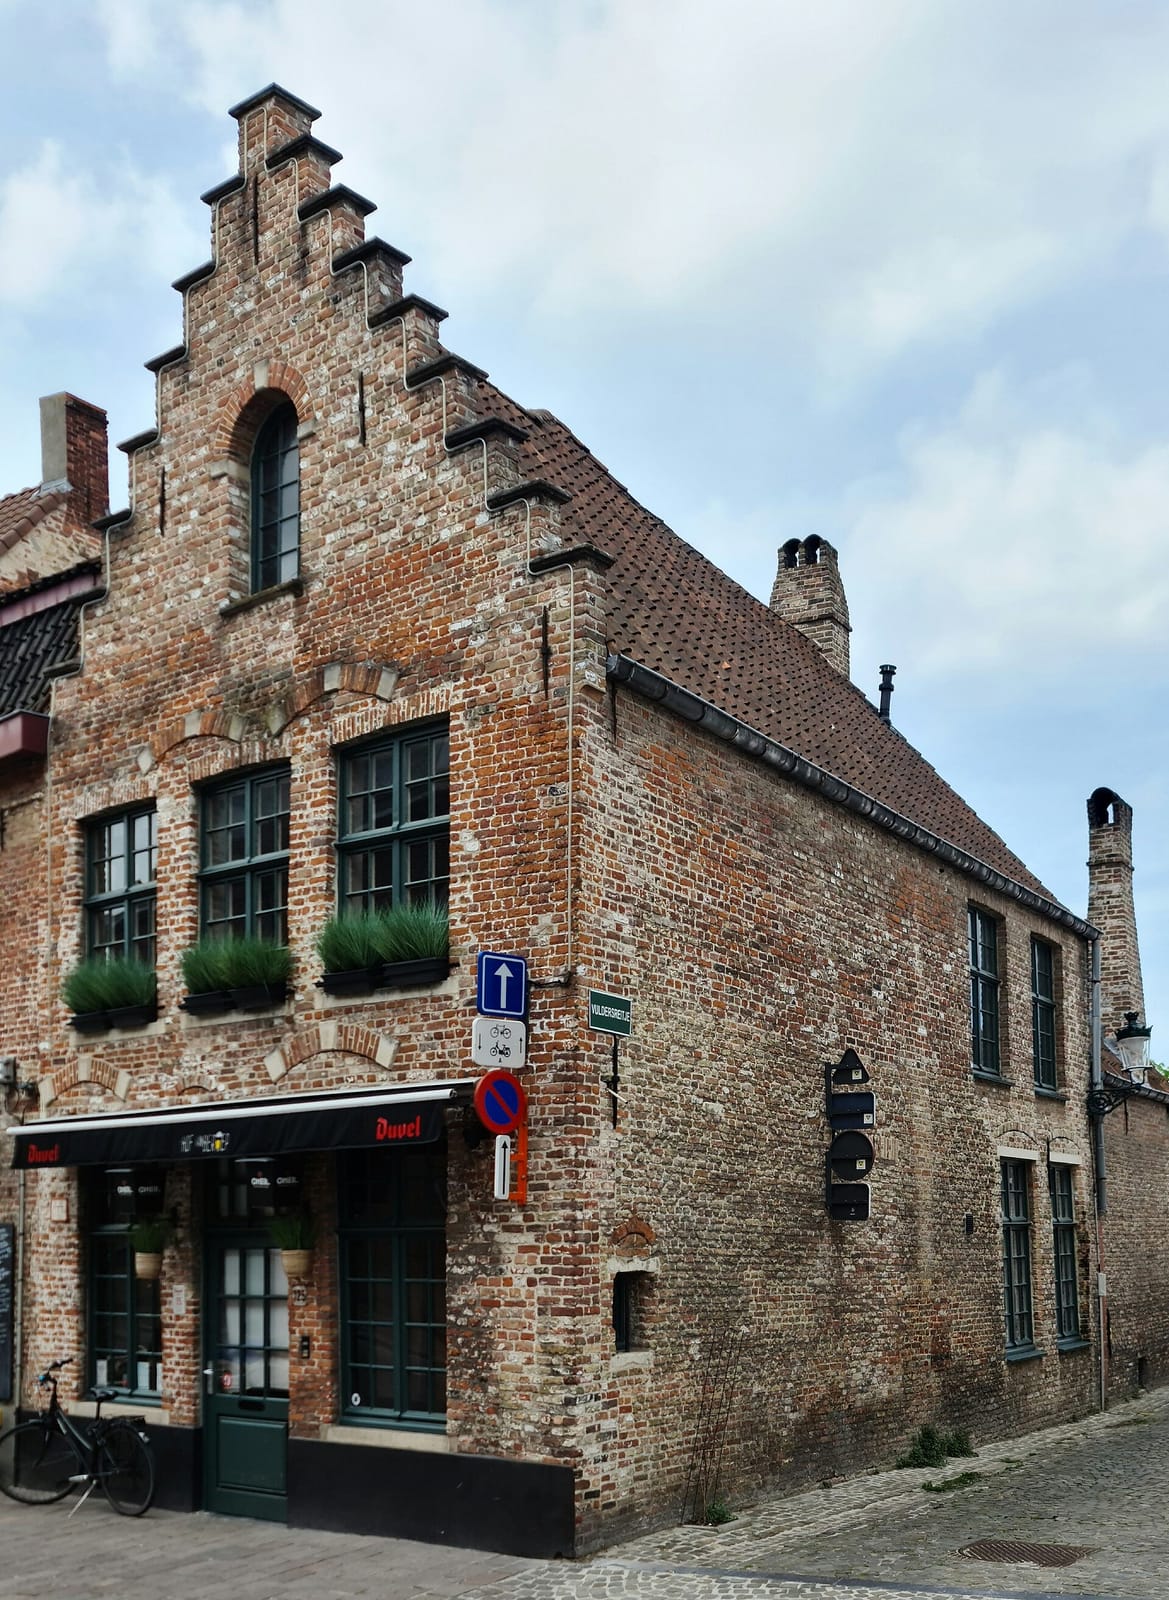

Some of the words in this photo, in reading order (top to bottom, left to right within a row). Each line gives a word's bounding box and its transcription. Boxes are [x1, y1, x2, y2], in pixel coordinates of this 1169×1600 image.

[591, 1004, 630, 1022] VULDERSREITJE
[376, 1115, 421, 1140] Duvel
[28, 1143, 59, 1163] Duvel
